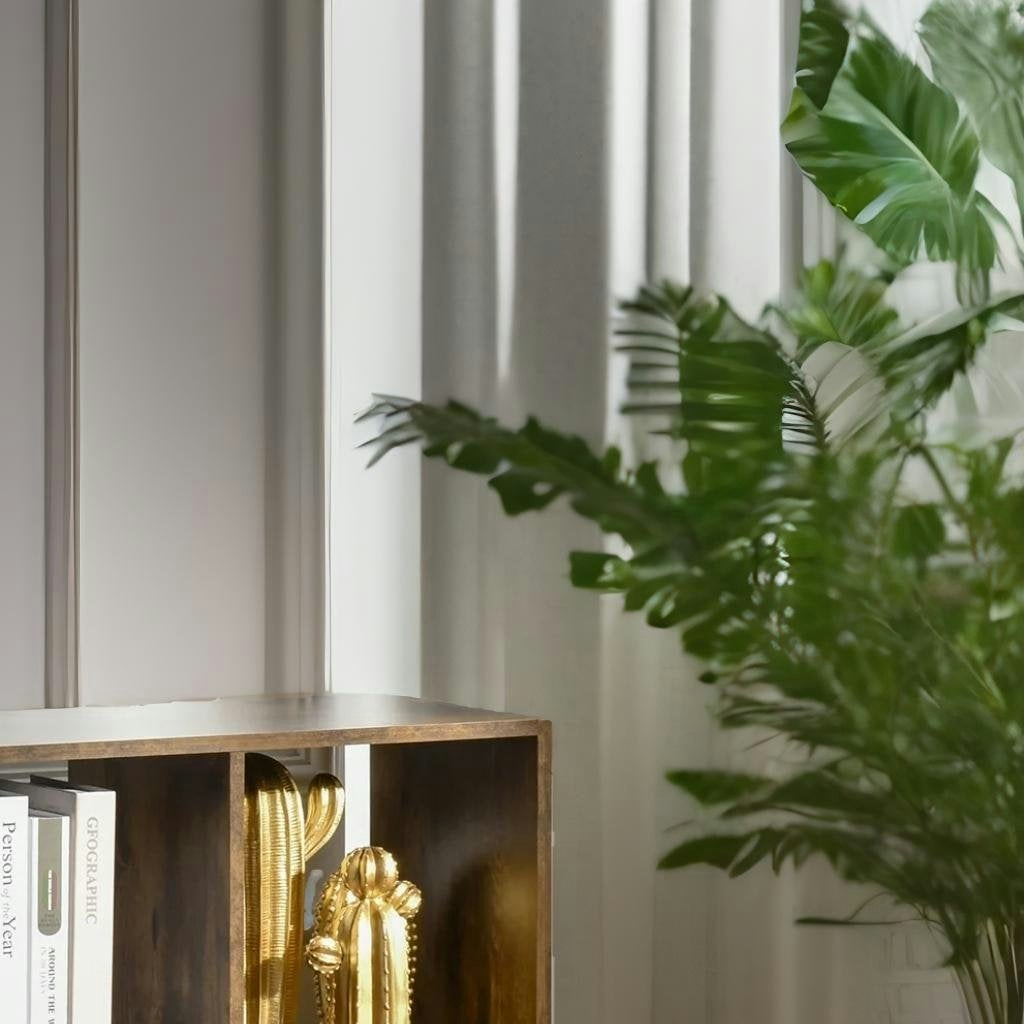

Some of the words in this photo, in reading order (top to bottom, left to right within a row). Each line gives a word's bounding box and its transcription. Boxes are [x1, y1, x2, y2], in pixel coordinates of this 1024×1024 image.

[2, 822, 16, 885] Person
[86, 816, 99, 925] GEOGRAPHIC
[2, 917, 16, 959] Year
